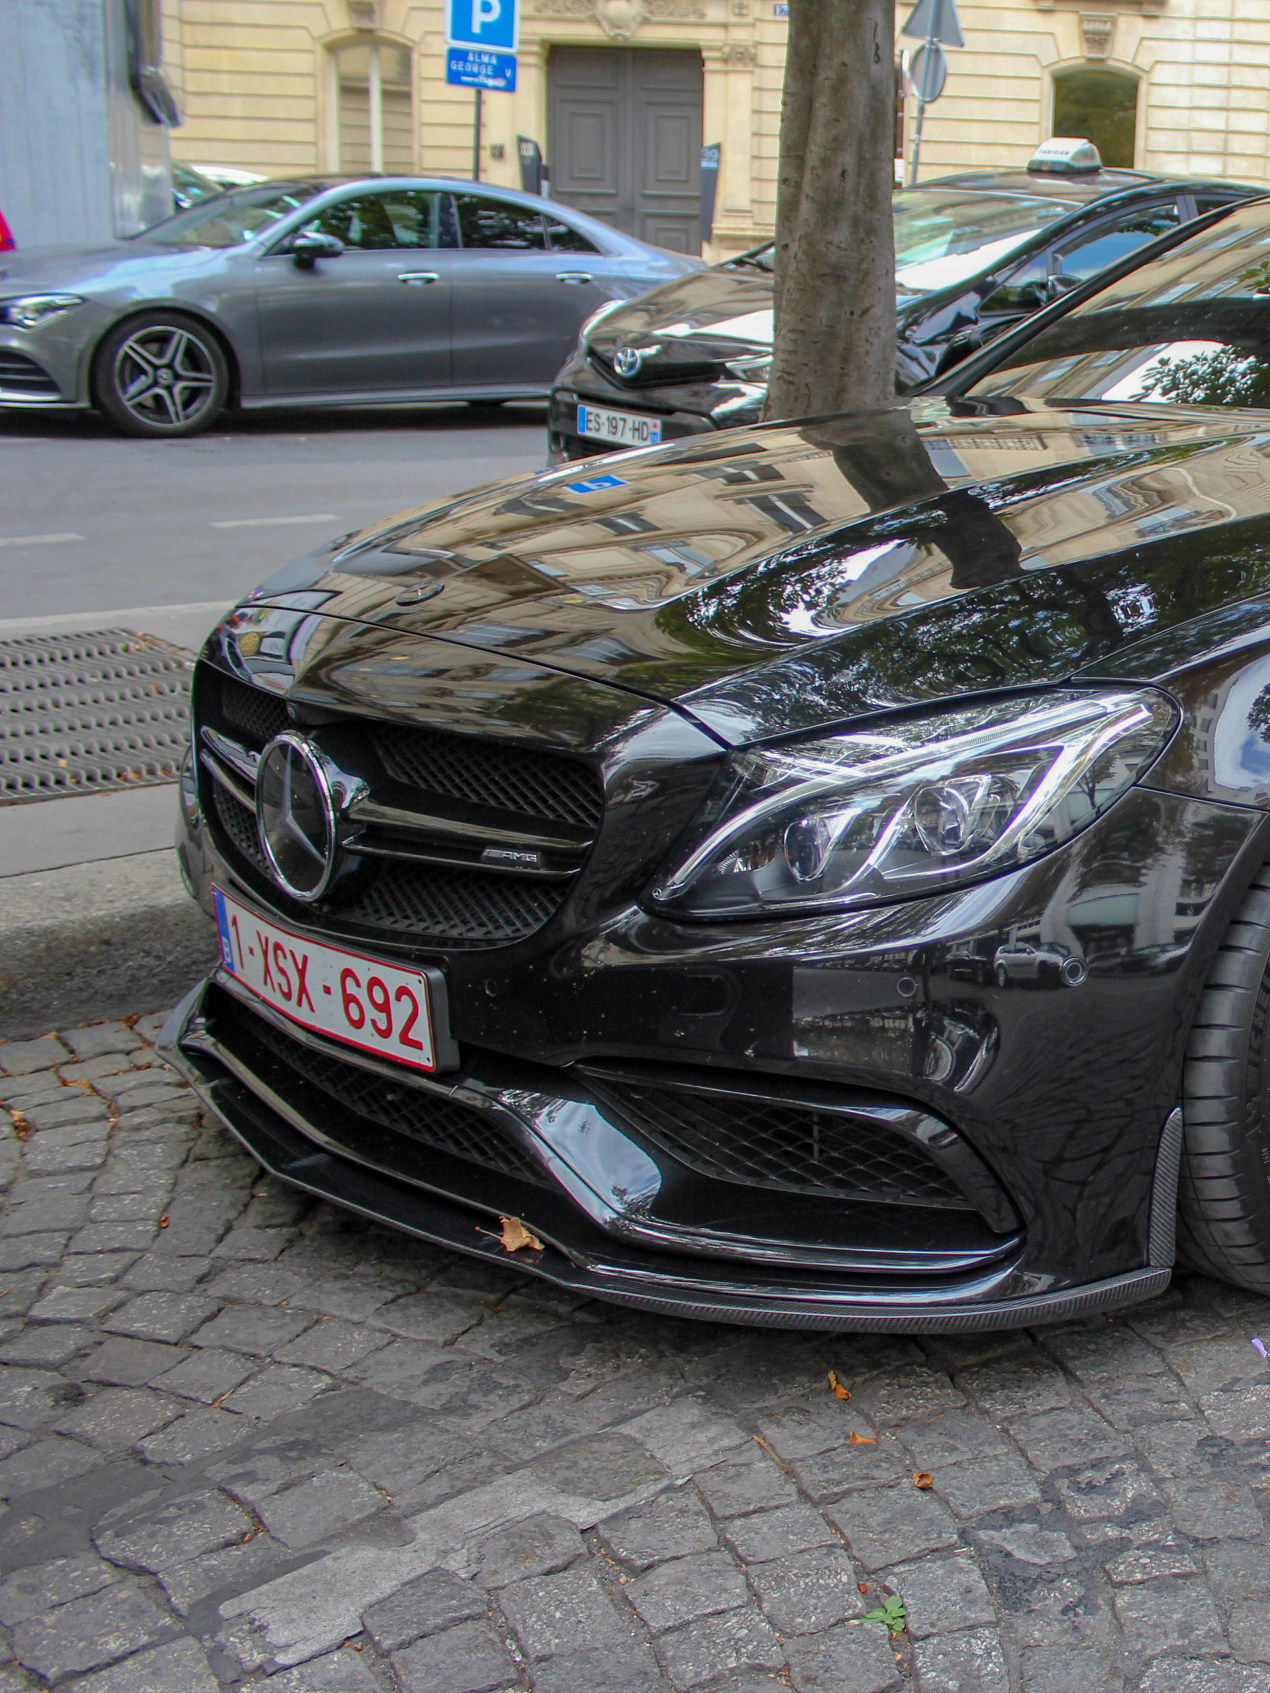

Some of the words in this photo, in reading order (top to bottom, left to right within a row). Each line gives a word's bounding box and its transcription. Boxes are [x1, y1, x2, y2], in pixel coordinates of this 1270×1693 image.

[467, 51, 498, 65] ALMA
[450, 60, 495, 76] GEORGE
[231, 914, 424, 1051] 1-XSX-692
